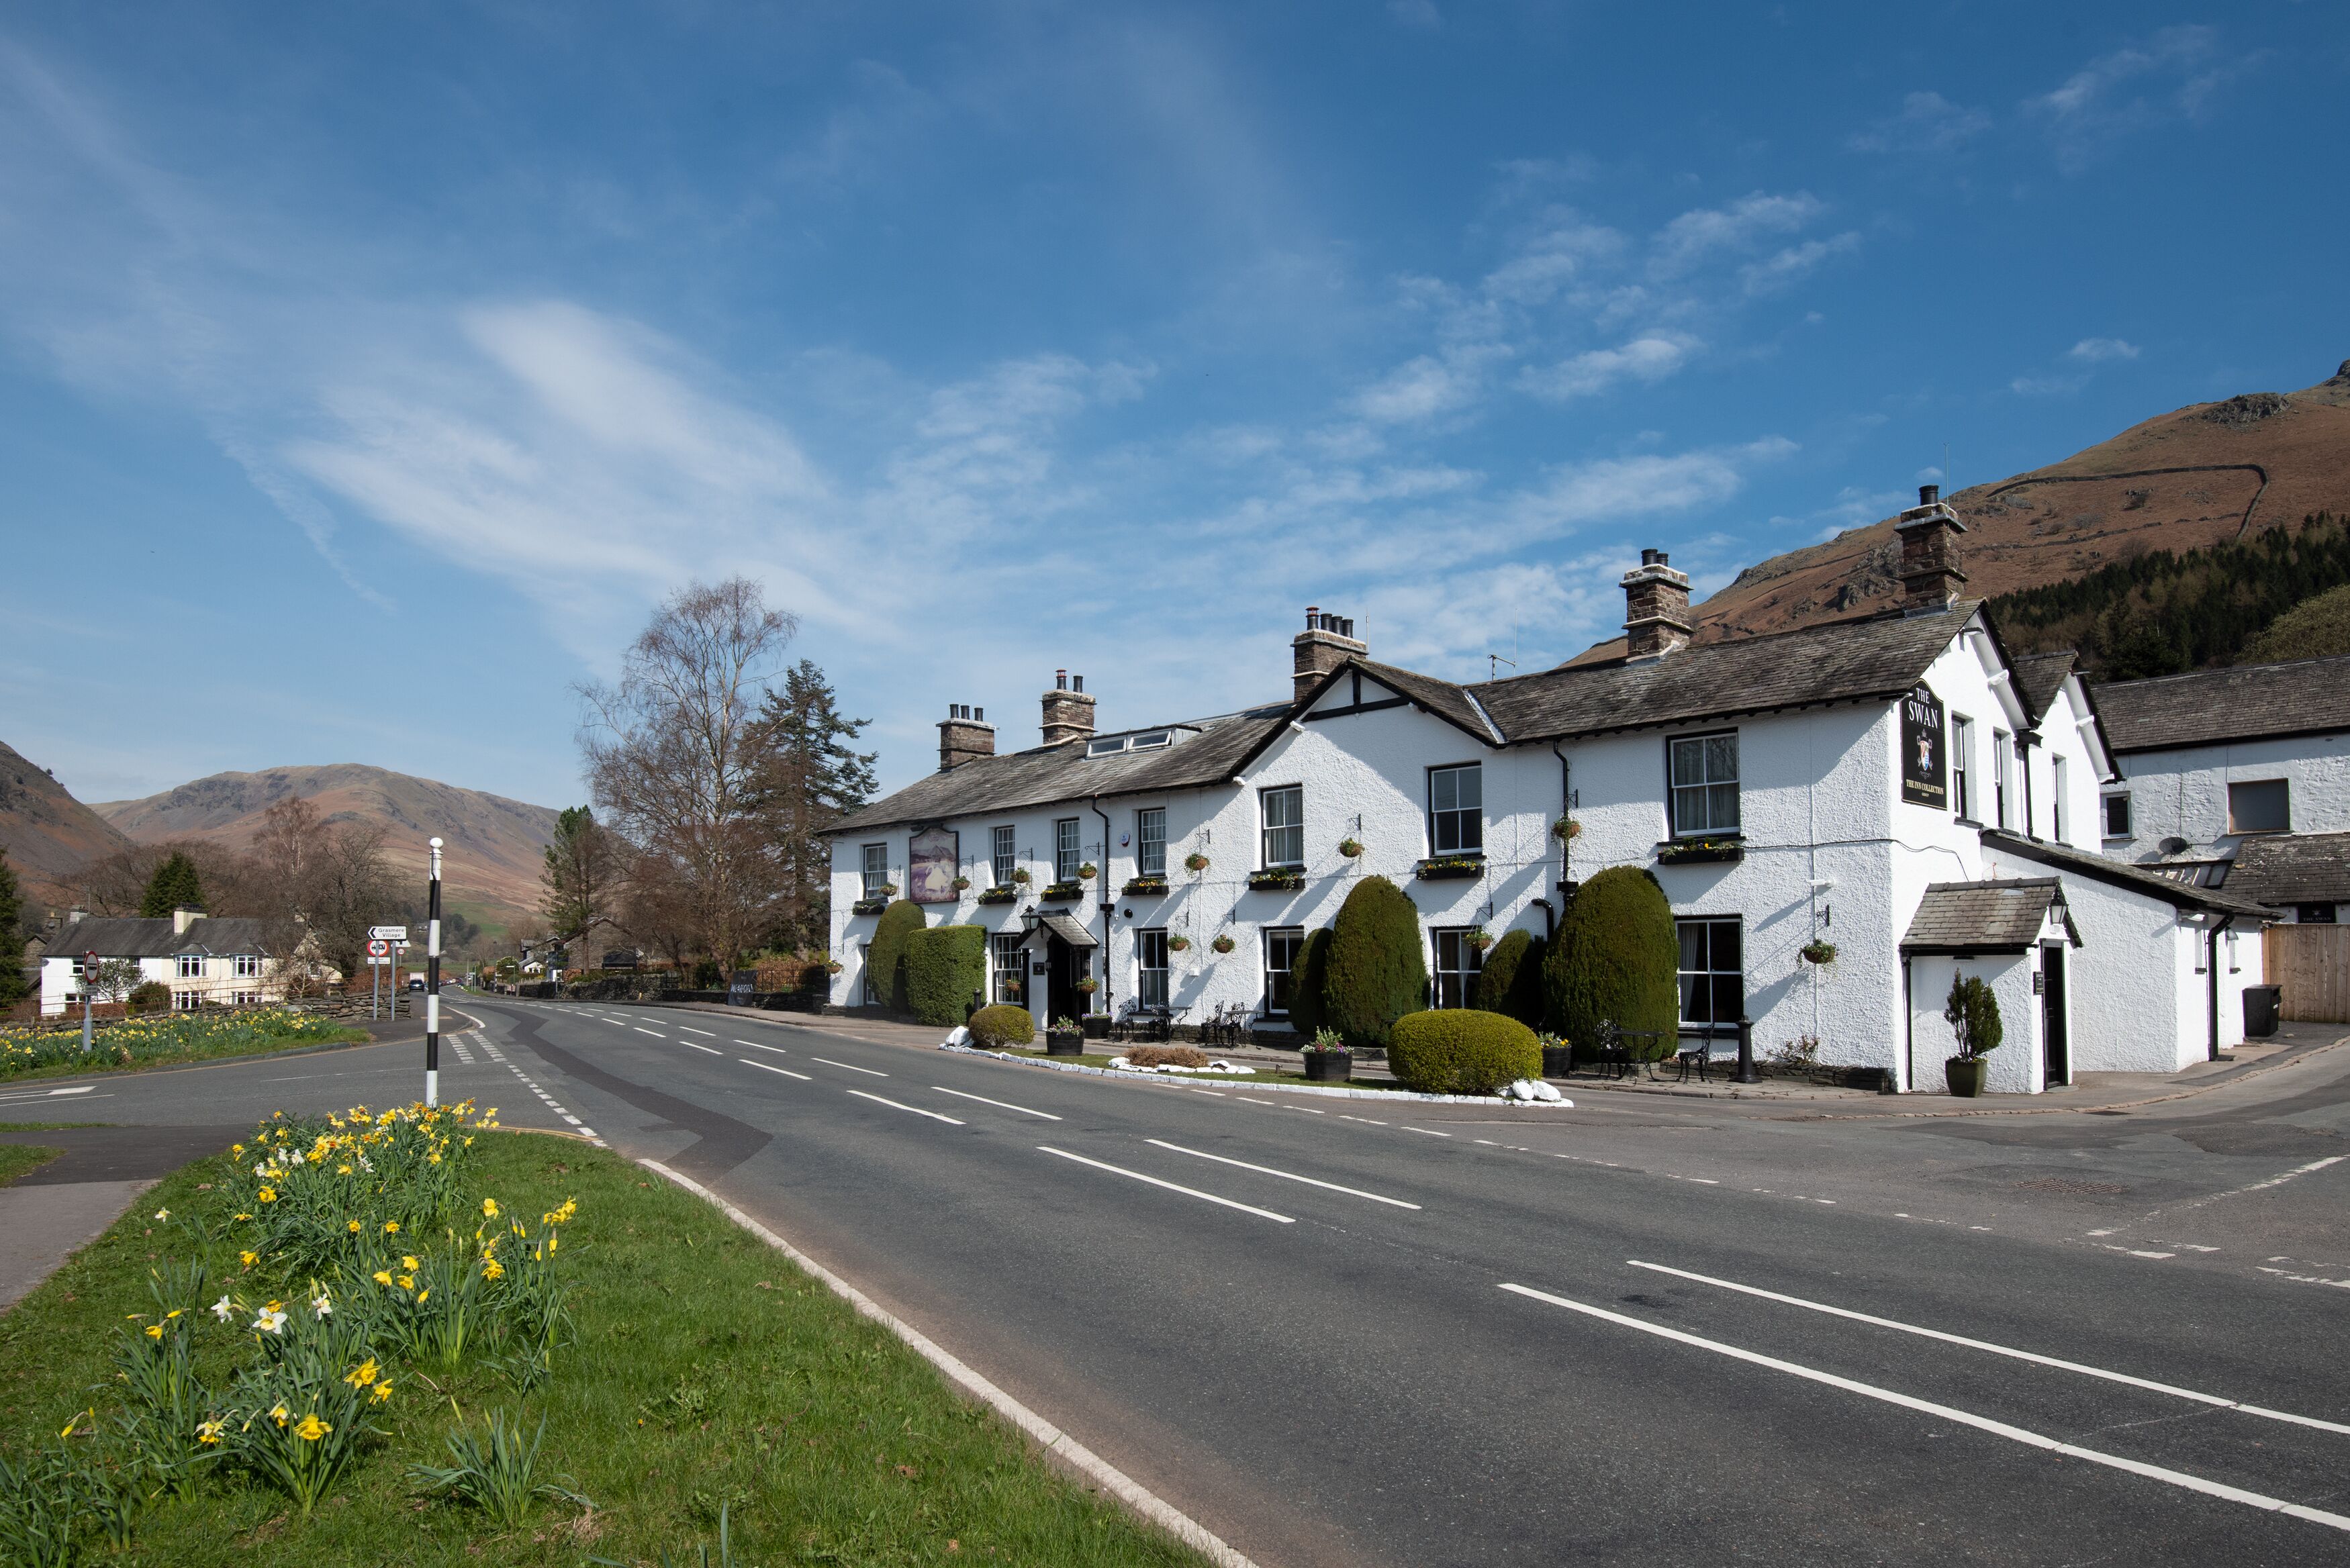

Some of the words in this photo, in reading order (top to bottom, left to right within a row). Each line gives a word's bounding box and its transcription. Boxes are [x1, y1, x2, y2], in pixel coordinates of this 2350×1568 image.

[1916, 687, 1930, 704] THE
[1909, 700, 1938, 730] SWAN
[1906, 779, 1914, 788] THE
[1921, 783, 1944, 795] COLLECTION
